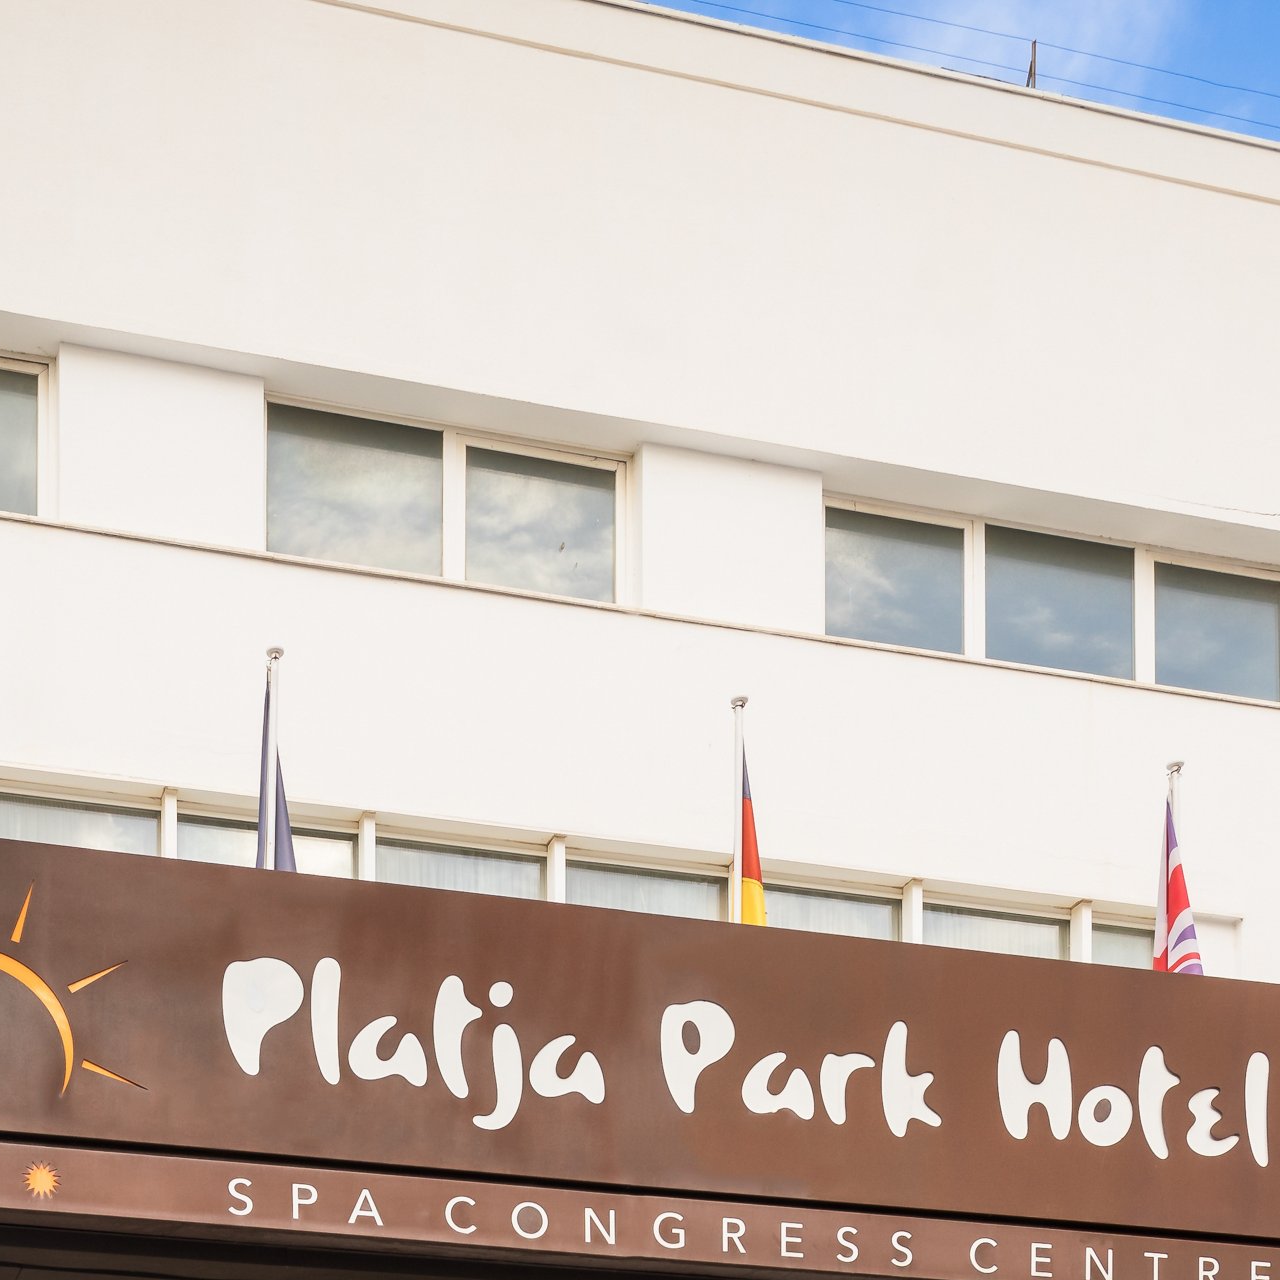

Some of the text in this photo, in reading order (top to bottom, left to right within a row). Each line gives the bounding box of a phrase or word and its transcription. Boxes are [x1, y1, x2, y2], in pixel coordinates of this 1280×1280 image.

[222, 957, 1270, 1168] Platja Park Hotel
[227, 1177, 384, 1227] SPA
[444, 1195, 913, 1267] CONGRESS
